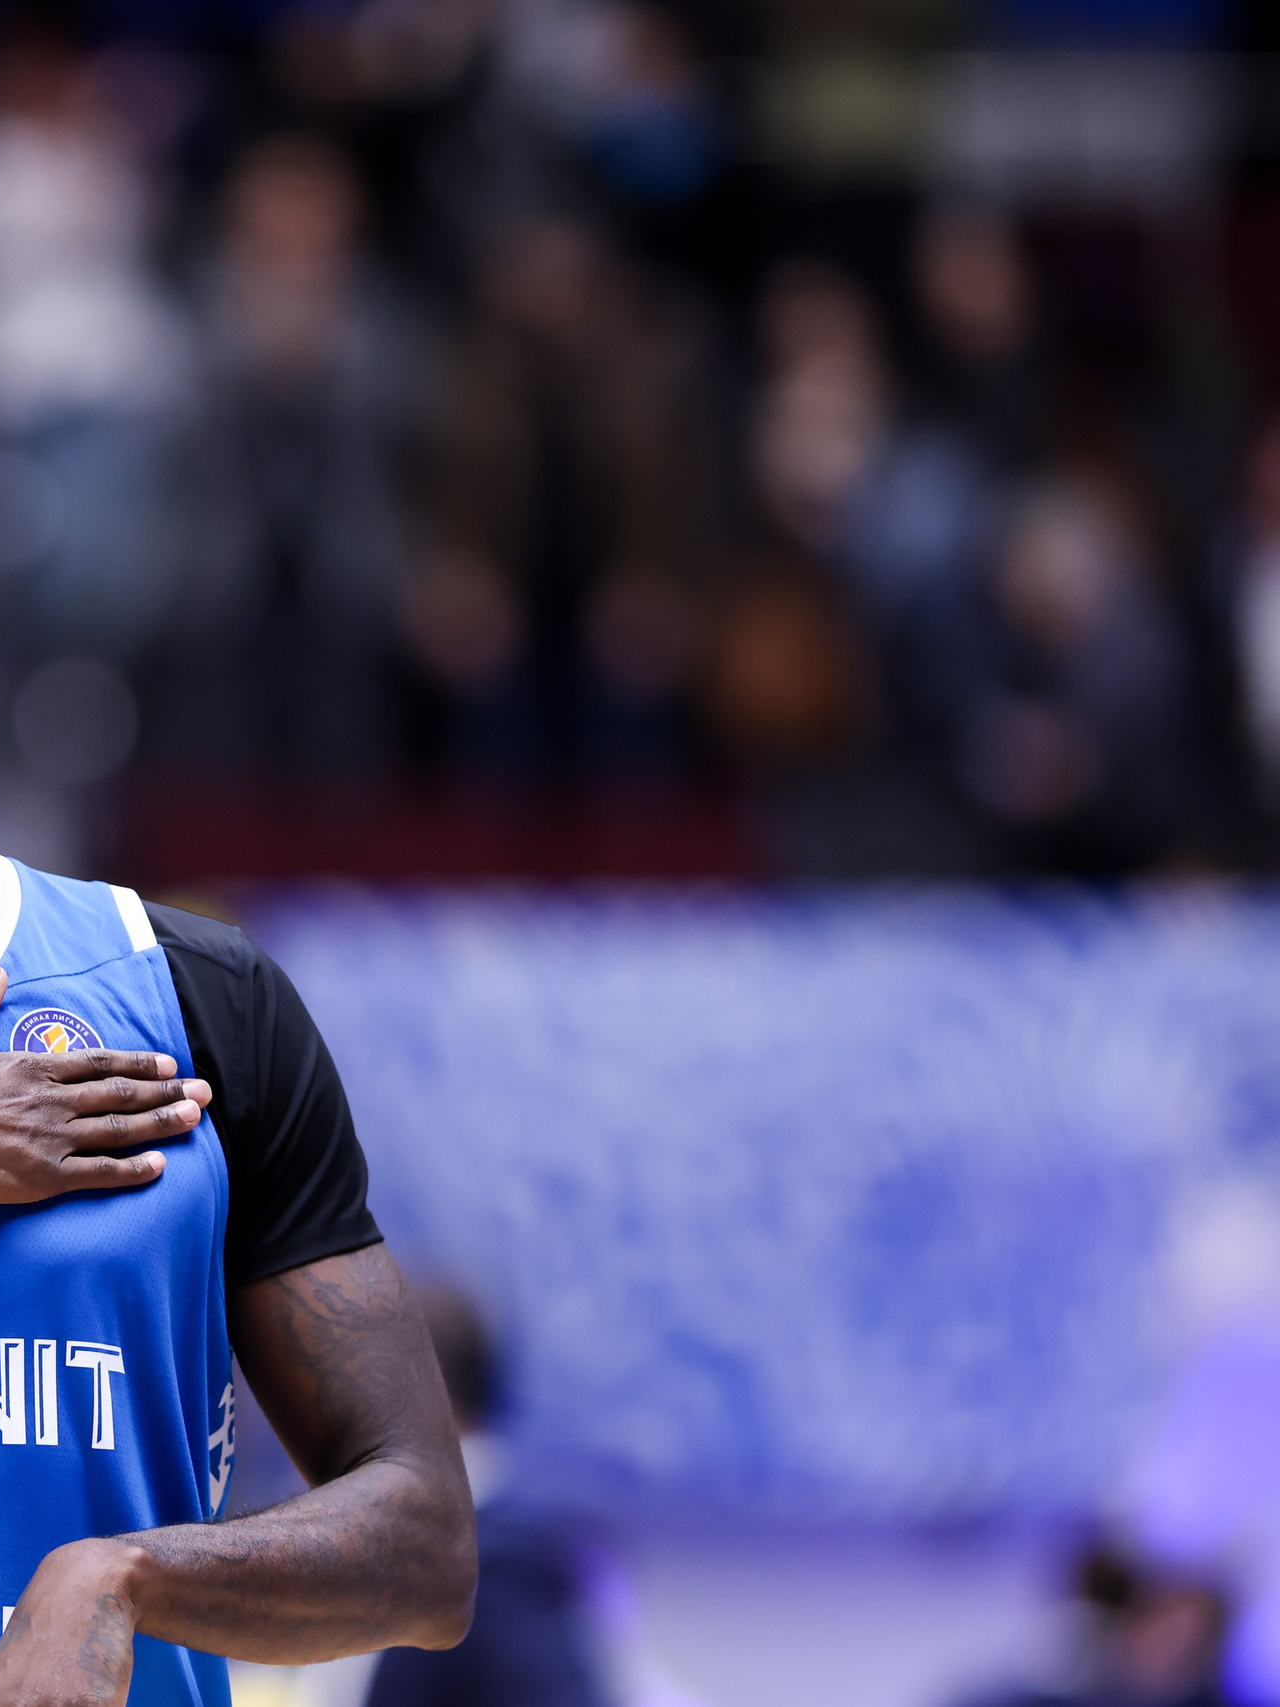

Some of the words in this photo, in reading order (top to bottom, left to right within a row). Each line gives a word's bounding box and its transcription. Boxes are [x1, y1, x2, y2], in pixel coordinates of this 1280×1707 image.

[21, 1014, 50, 1032] ЕДИНАЯ
[52, 1013, 75, 1025] ЛИГА
[75, 1023, 90, 1037] ВТБ
